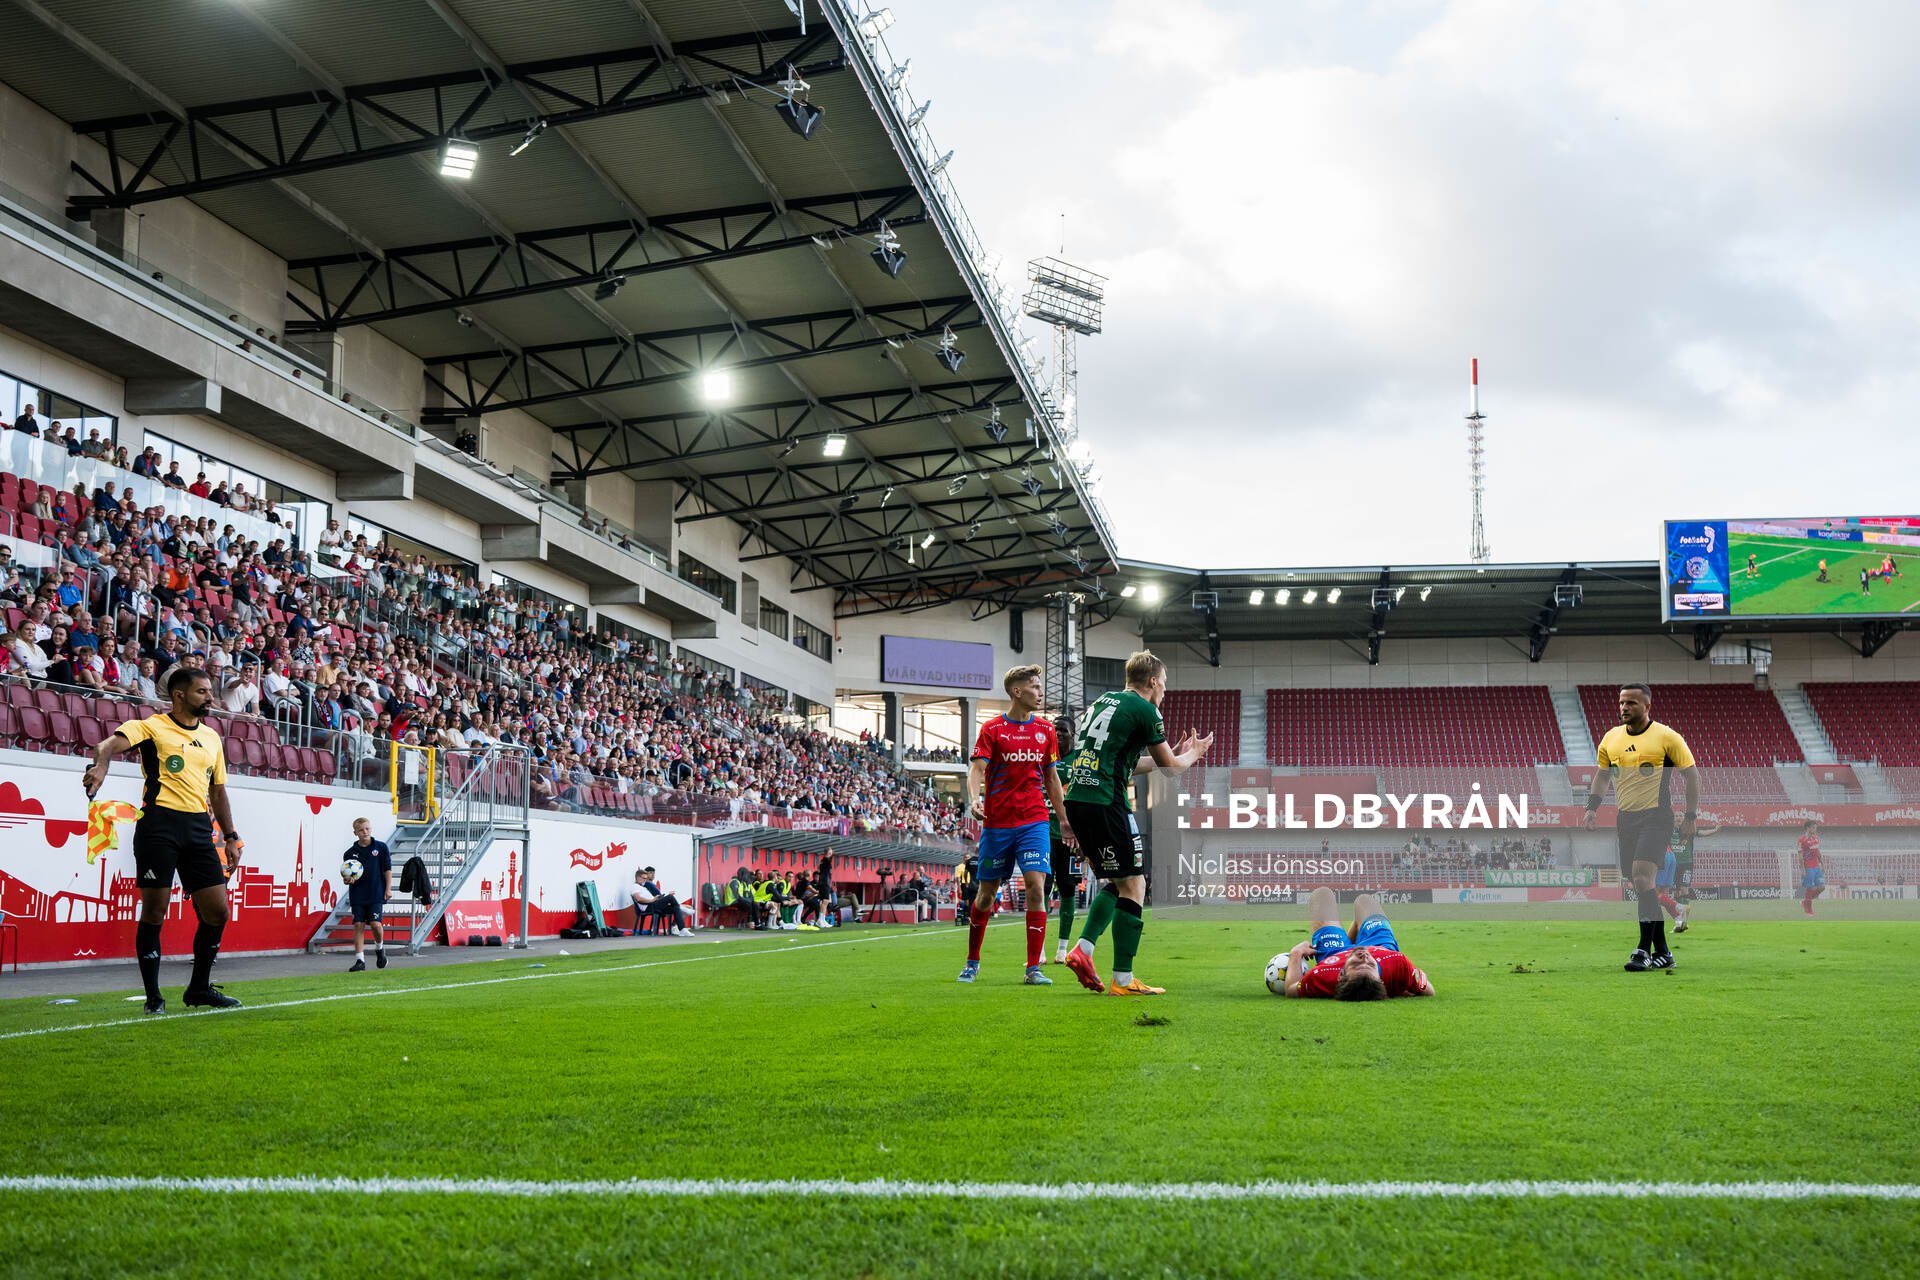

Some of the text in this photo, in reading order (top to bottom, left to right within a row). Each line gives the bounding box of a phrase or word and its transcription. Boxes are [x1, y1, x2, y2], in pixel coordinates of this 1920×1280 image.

[888, 667, 992, 685] VI ÄR VAD VI HETER
[1074, 705, 1117, 750] 24
[1002, 749, 1044, 762] vobbiz
[1769, 808, 1825, 823] RAMLÖSA
[1098, 845, 1116, 860] VS
[1489, 871, 1587, 885] VARBERGS
